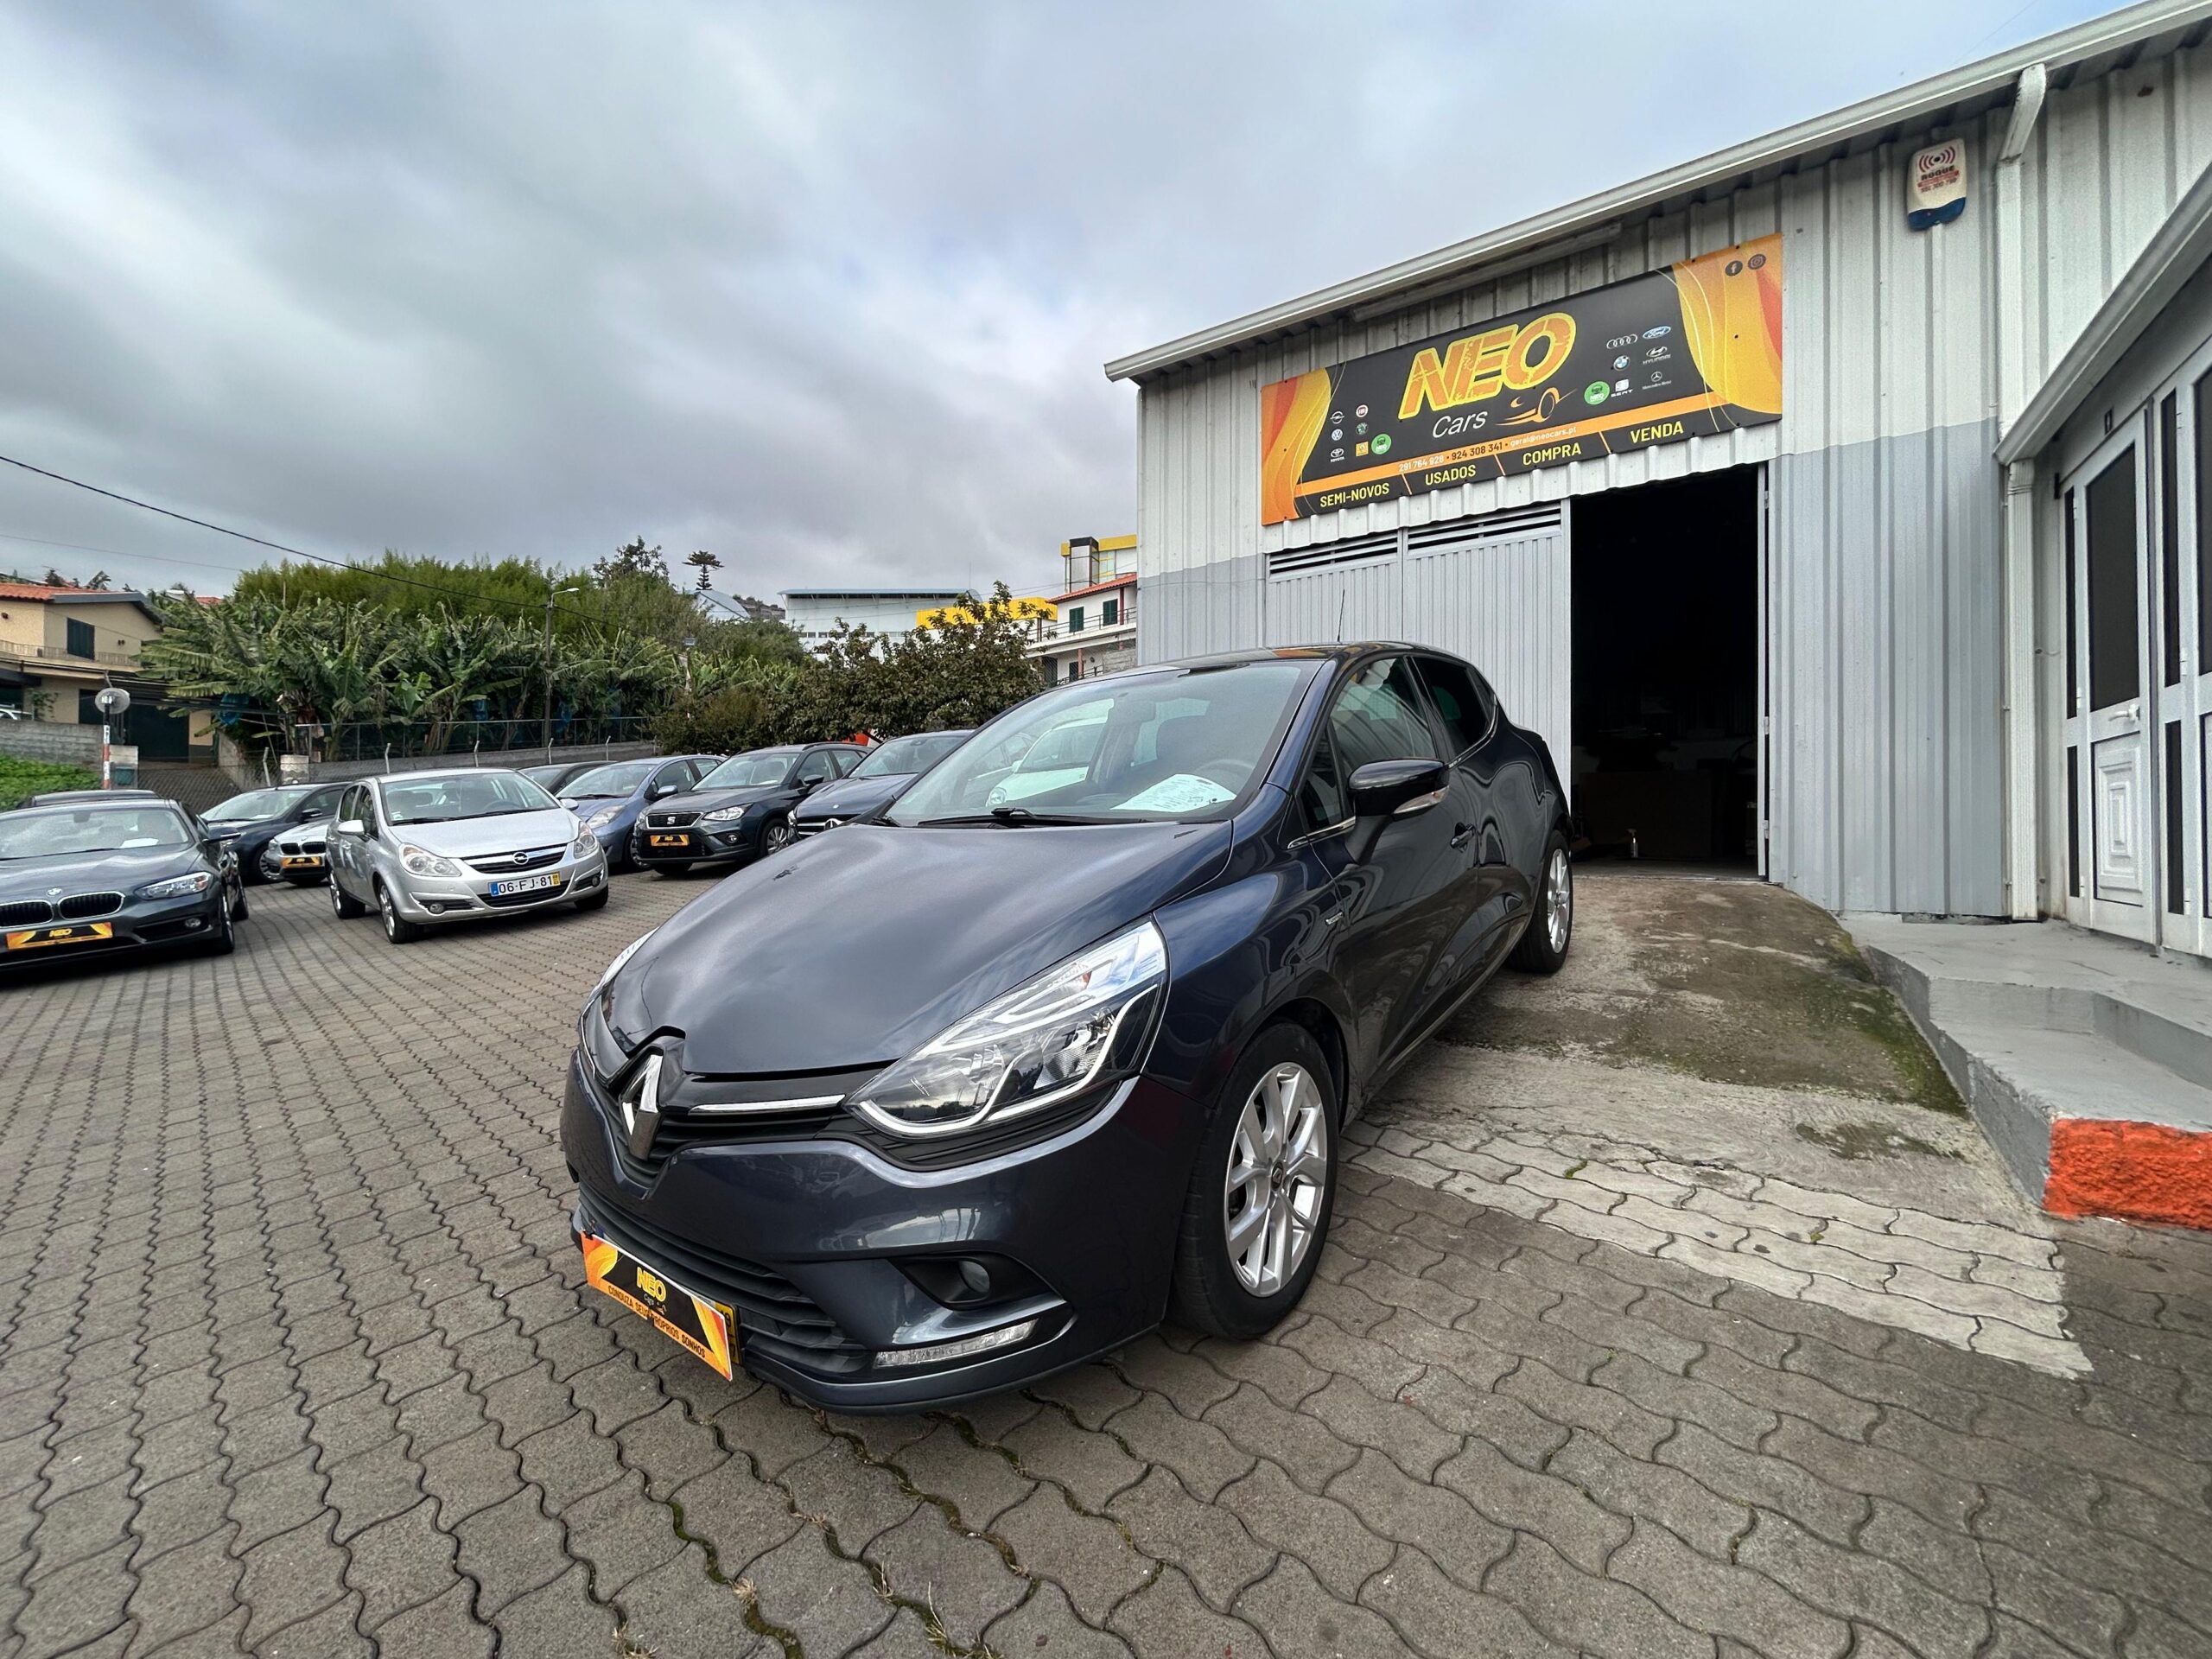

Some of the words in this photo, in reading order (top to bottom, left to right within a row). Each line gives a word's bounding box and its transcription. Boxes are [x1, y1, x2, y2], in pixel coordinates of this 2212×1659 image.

[1398, 313, 1576, 420] NEO
[1433, 411, 1488, 438] Cars
[1630, 421, 1684, 443] VENDA
[1452, 450, 1467, 461] 924
[1470, 446, 1486, 456] 308
[1488, 442, 1503, 453] 341
[1522, 442, 1582, 466] COMPRA
[1425, 465, 1476, 486] USADOS
[1319, 483, 1390, 508] SEMI-NOVOS
[637, 1267, 666, 1302] NEO
[681, 1334, 706, 1358] SONHOS
